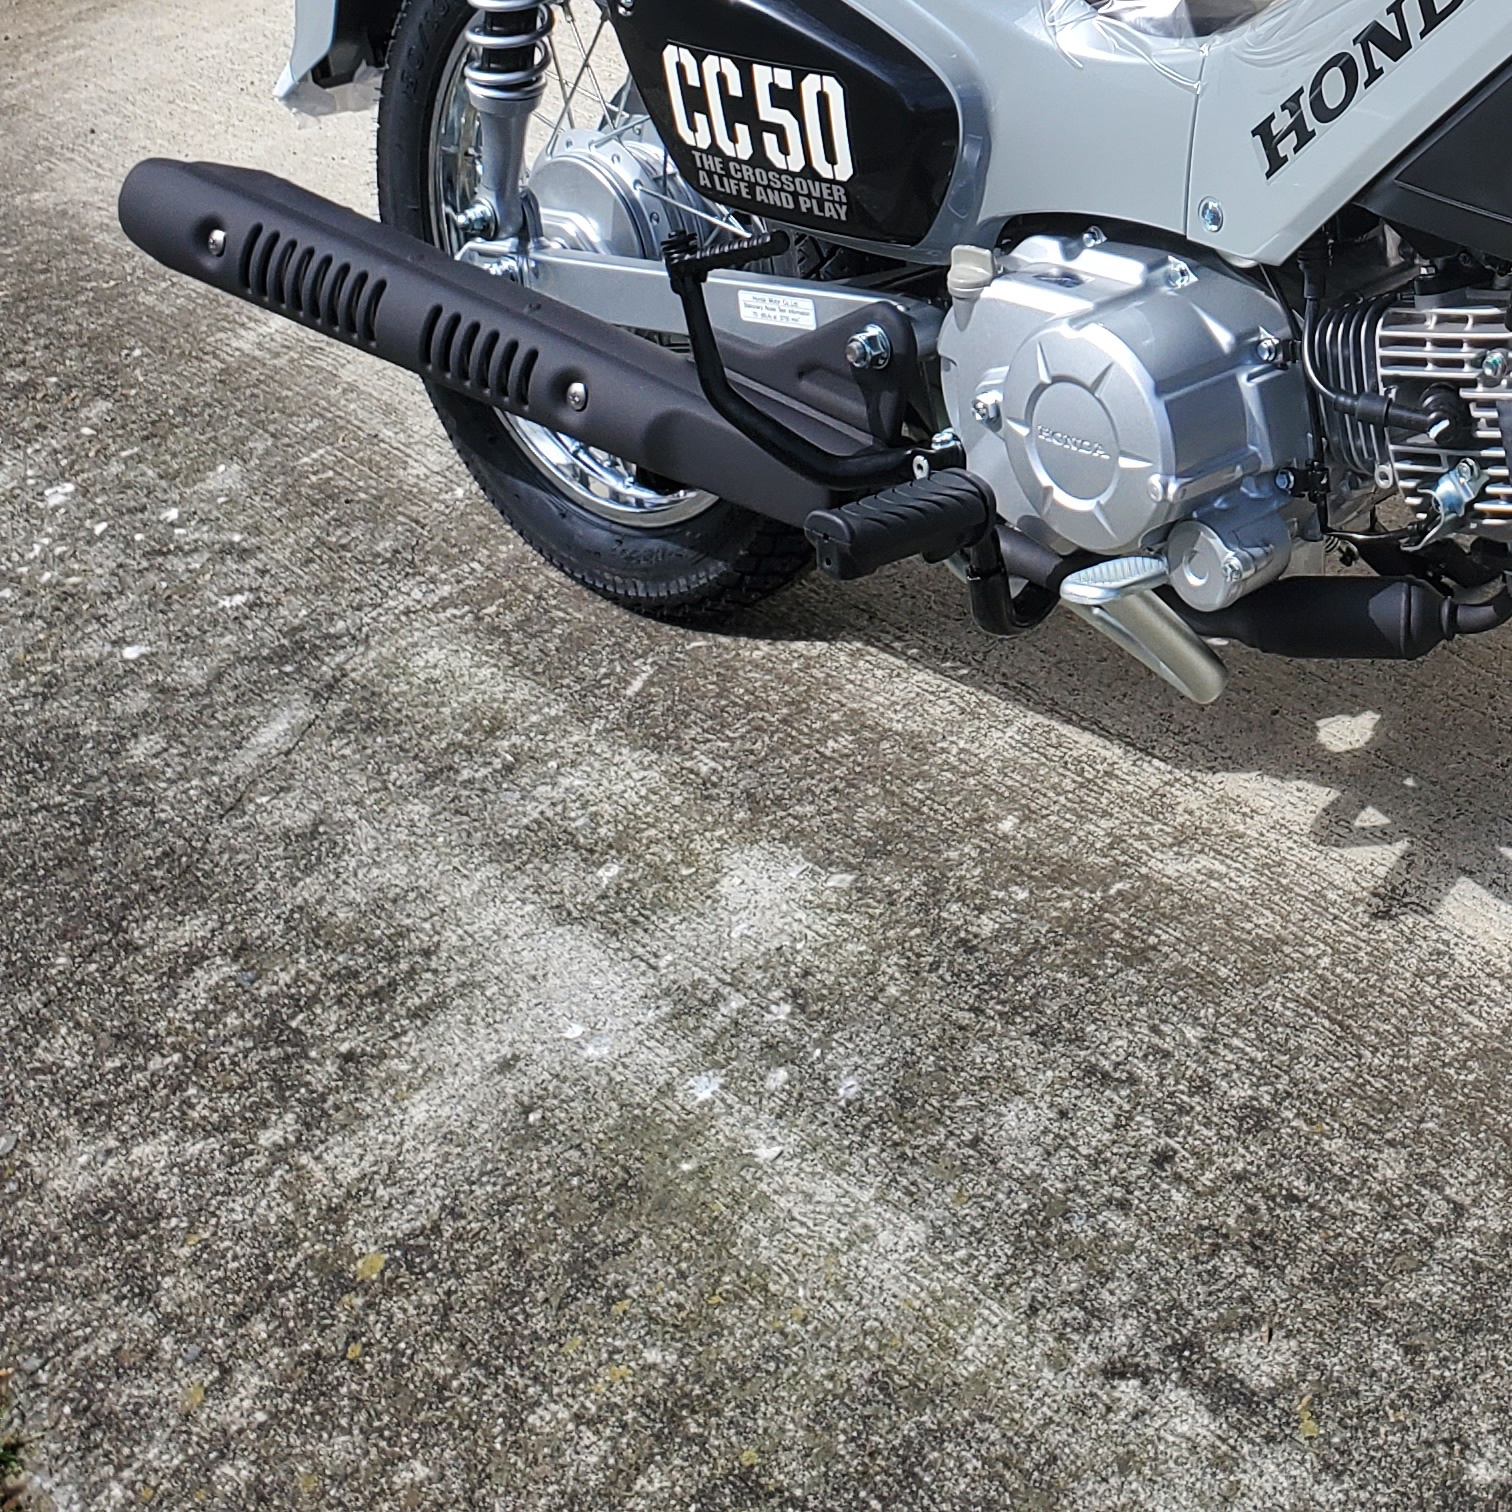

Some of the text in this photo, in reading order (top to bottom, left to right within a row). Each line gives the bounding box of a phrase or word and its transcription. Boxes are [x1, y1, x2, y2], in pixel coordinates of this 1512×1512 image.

[661, 43, 853, 182] CC50
[692, 150, 848, 204] THE CROSSOVER
[698, 170, 849, 222] A LIFE AND PLAY
[1037, 423, 1110, 460] HONDA
